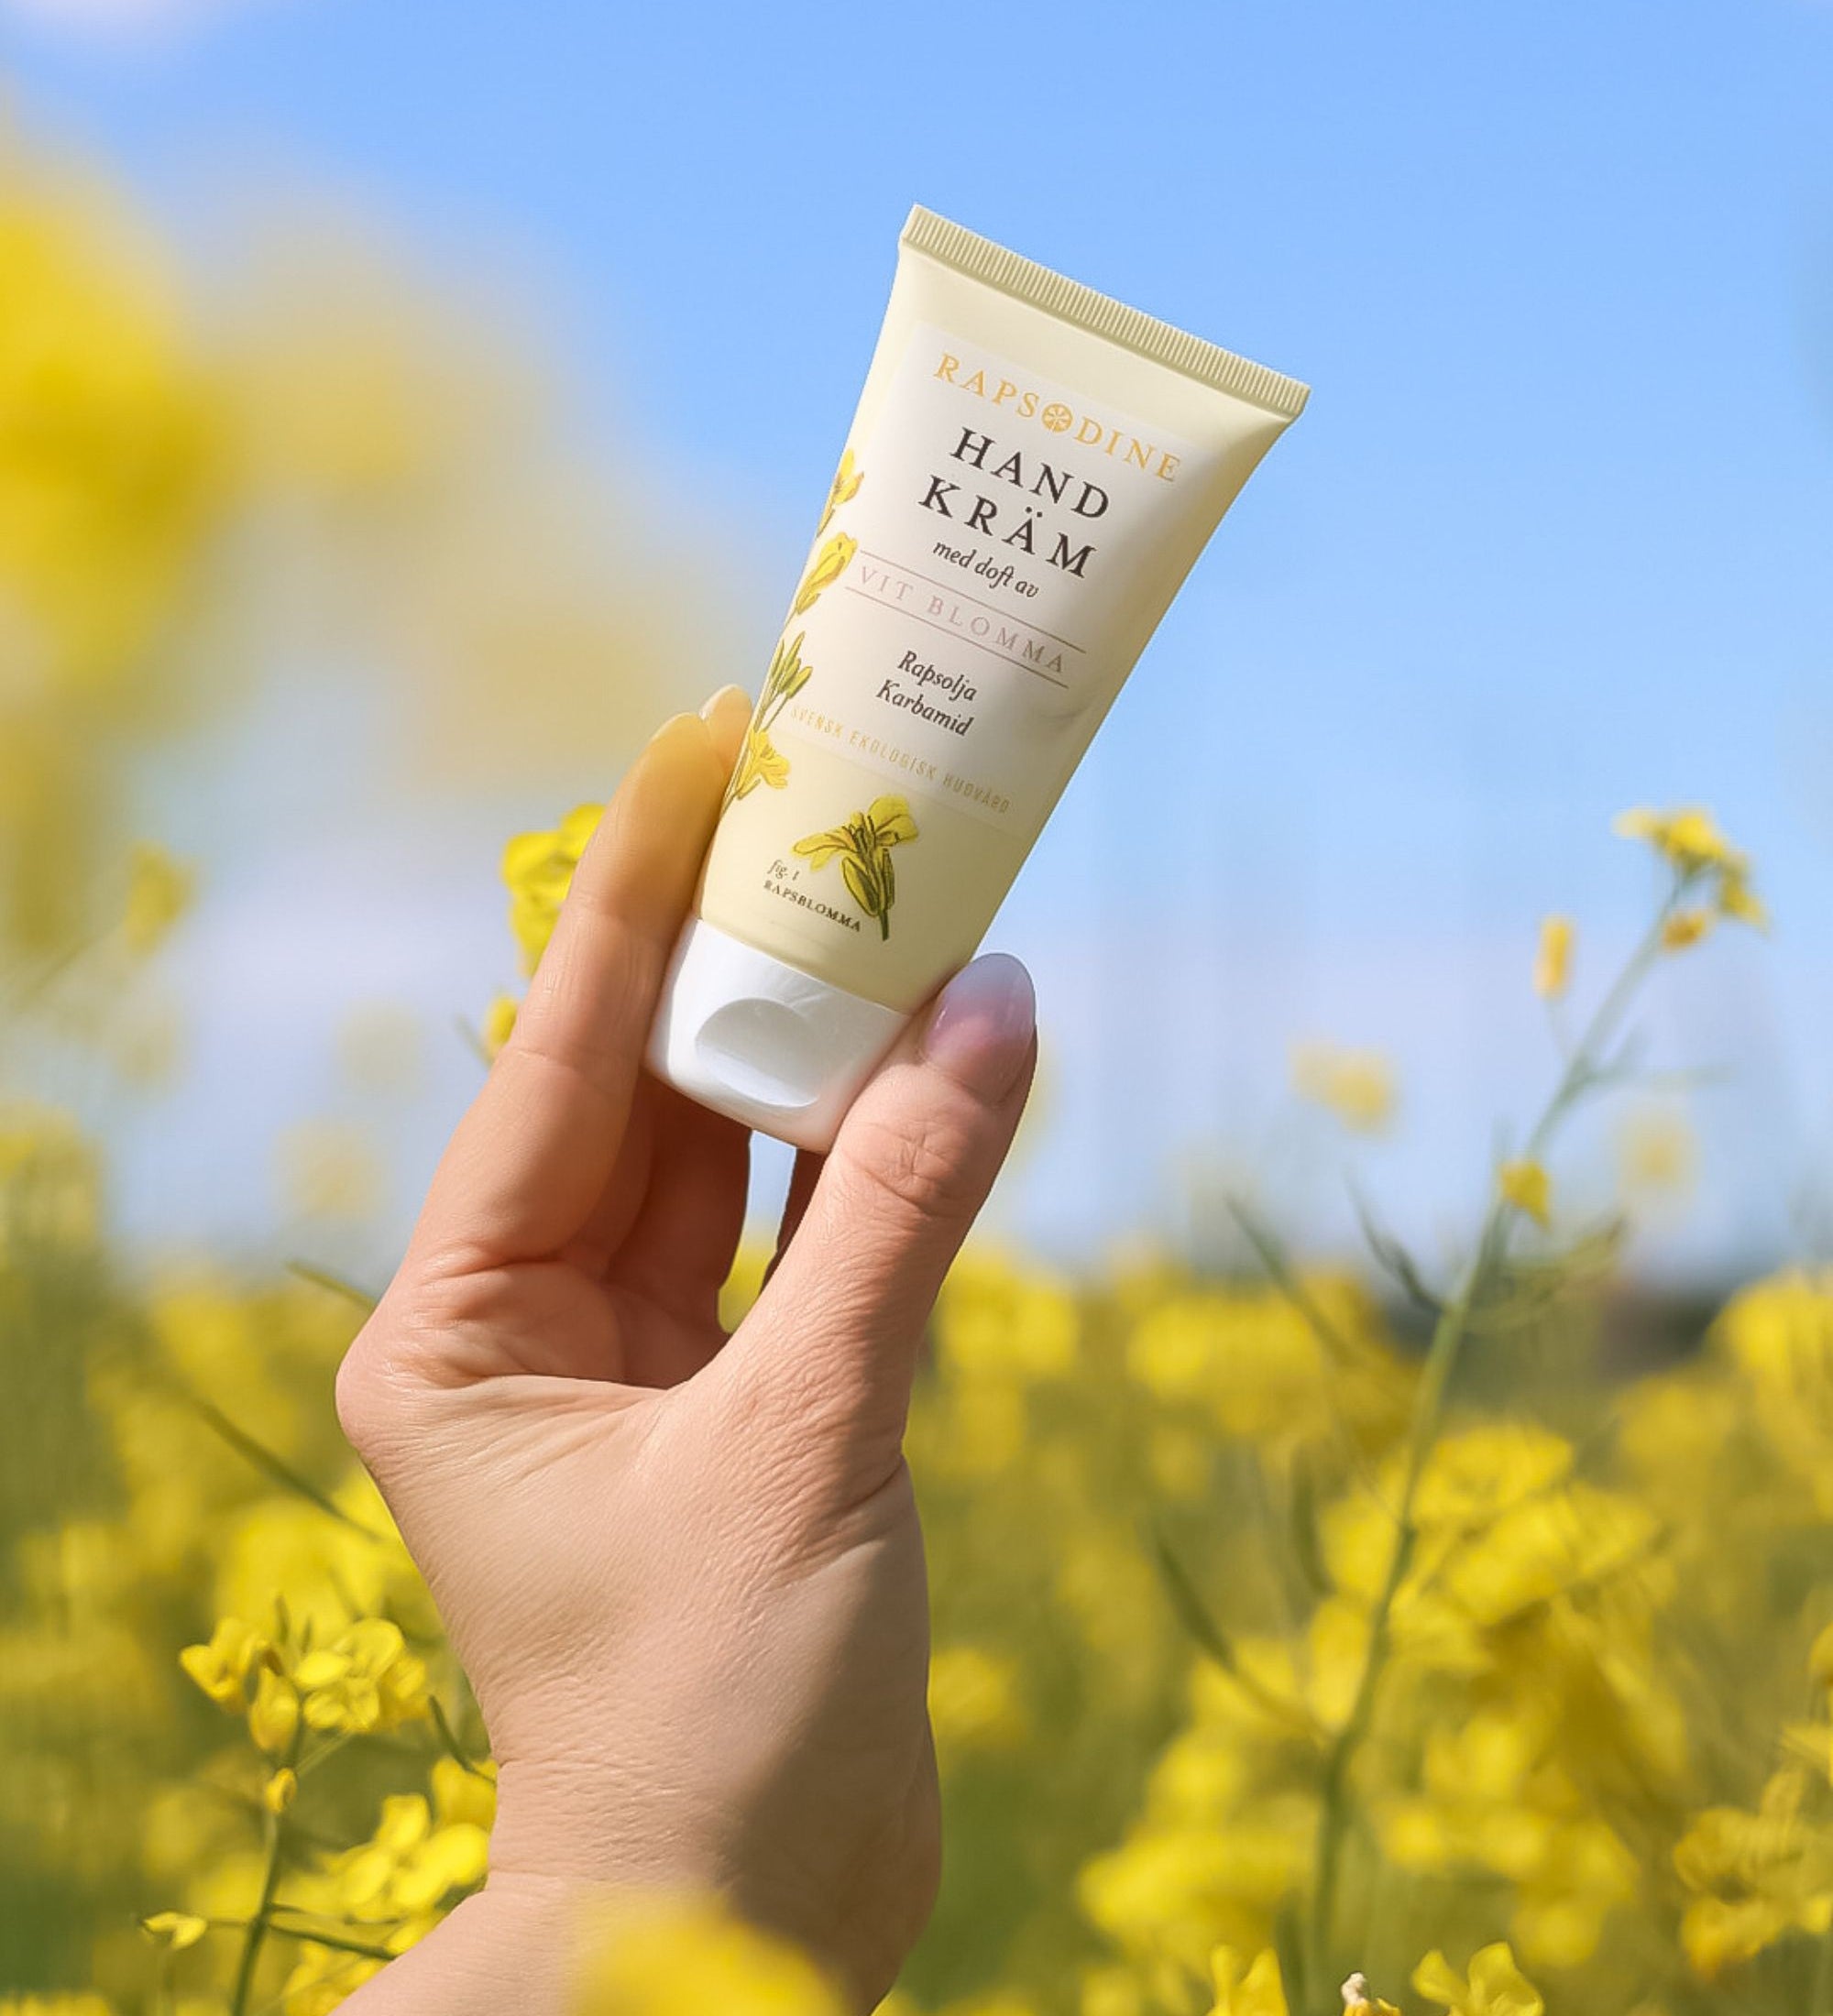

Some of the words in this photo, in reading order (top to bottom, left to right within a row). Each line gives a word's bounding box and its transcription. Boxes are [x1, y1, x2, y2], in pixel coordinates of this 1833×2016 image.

[933, 353, 1181, 482] RAPSODINE
[949, 427, 1110, 519] HAND
[917, 475, 1099, 579] KRÄM
[932, 541, 977, 568] med
[975, 559, 1015, 589] doft
[1015, 580, 1040, 597] av
[861, 565, 914, 600] VIT
[927, 596, 1064, 674] BLOMMA
[876, 679, 975, 737] Karbamid
[897, 651, 978, 702] Rapsolja
[790, 706, 844, 739] SVENSK
[849, 731, 937, 780] EKOLOGISK
[942, 772, 1011, 814] HUDVÅRD
[763, 880, 862, 932] RAPSBLOMMA
